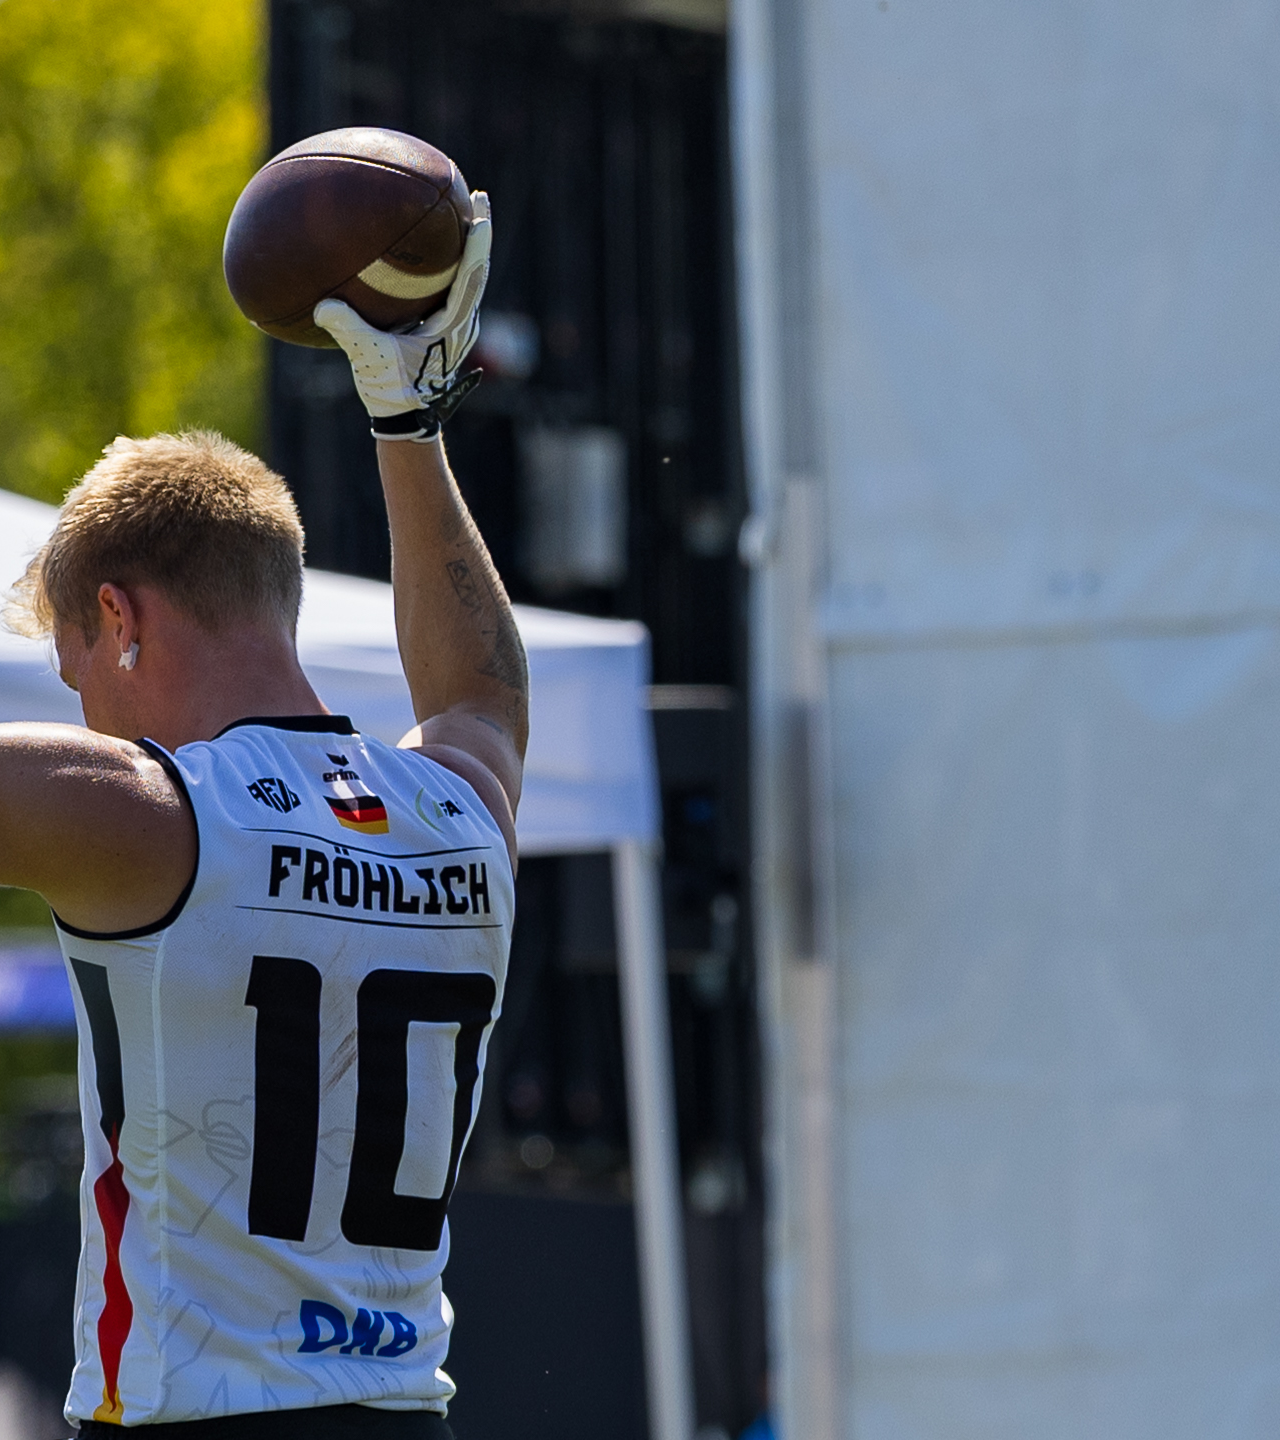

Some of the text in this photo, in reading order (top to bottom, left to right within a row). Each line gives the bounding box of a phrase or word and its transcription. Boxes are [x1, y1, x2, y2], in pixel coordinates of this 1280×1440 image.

[247, 777, 302, 814] AFVD
[269, 845, 491, 915] FRÖHLICH
[244, 955, 496, 1252] 10
[297, 1299, 418, 1357] DNB
